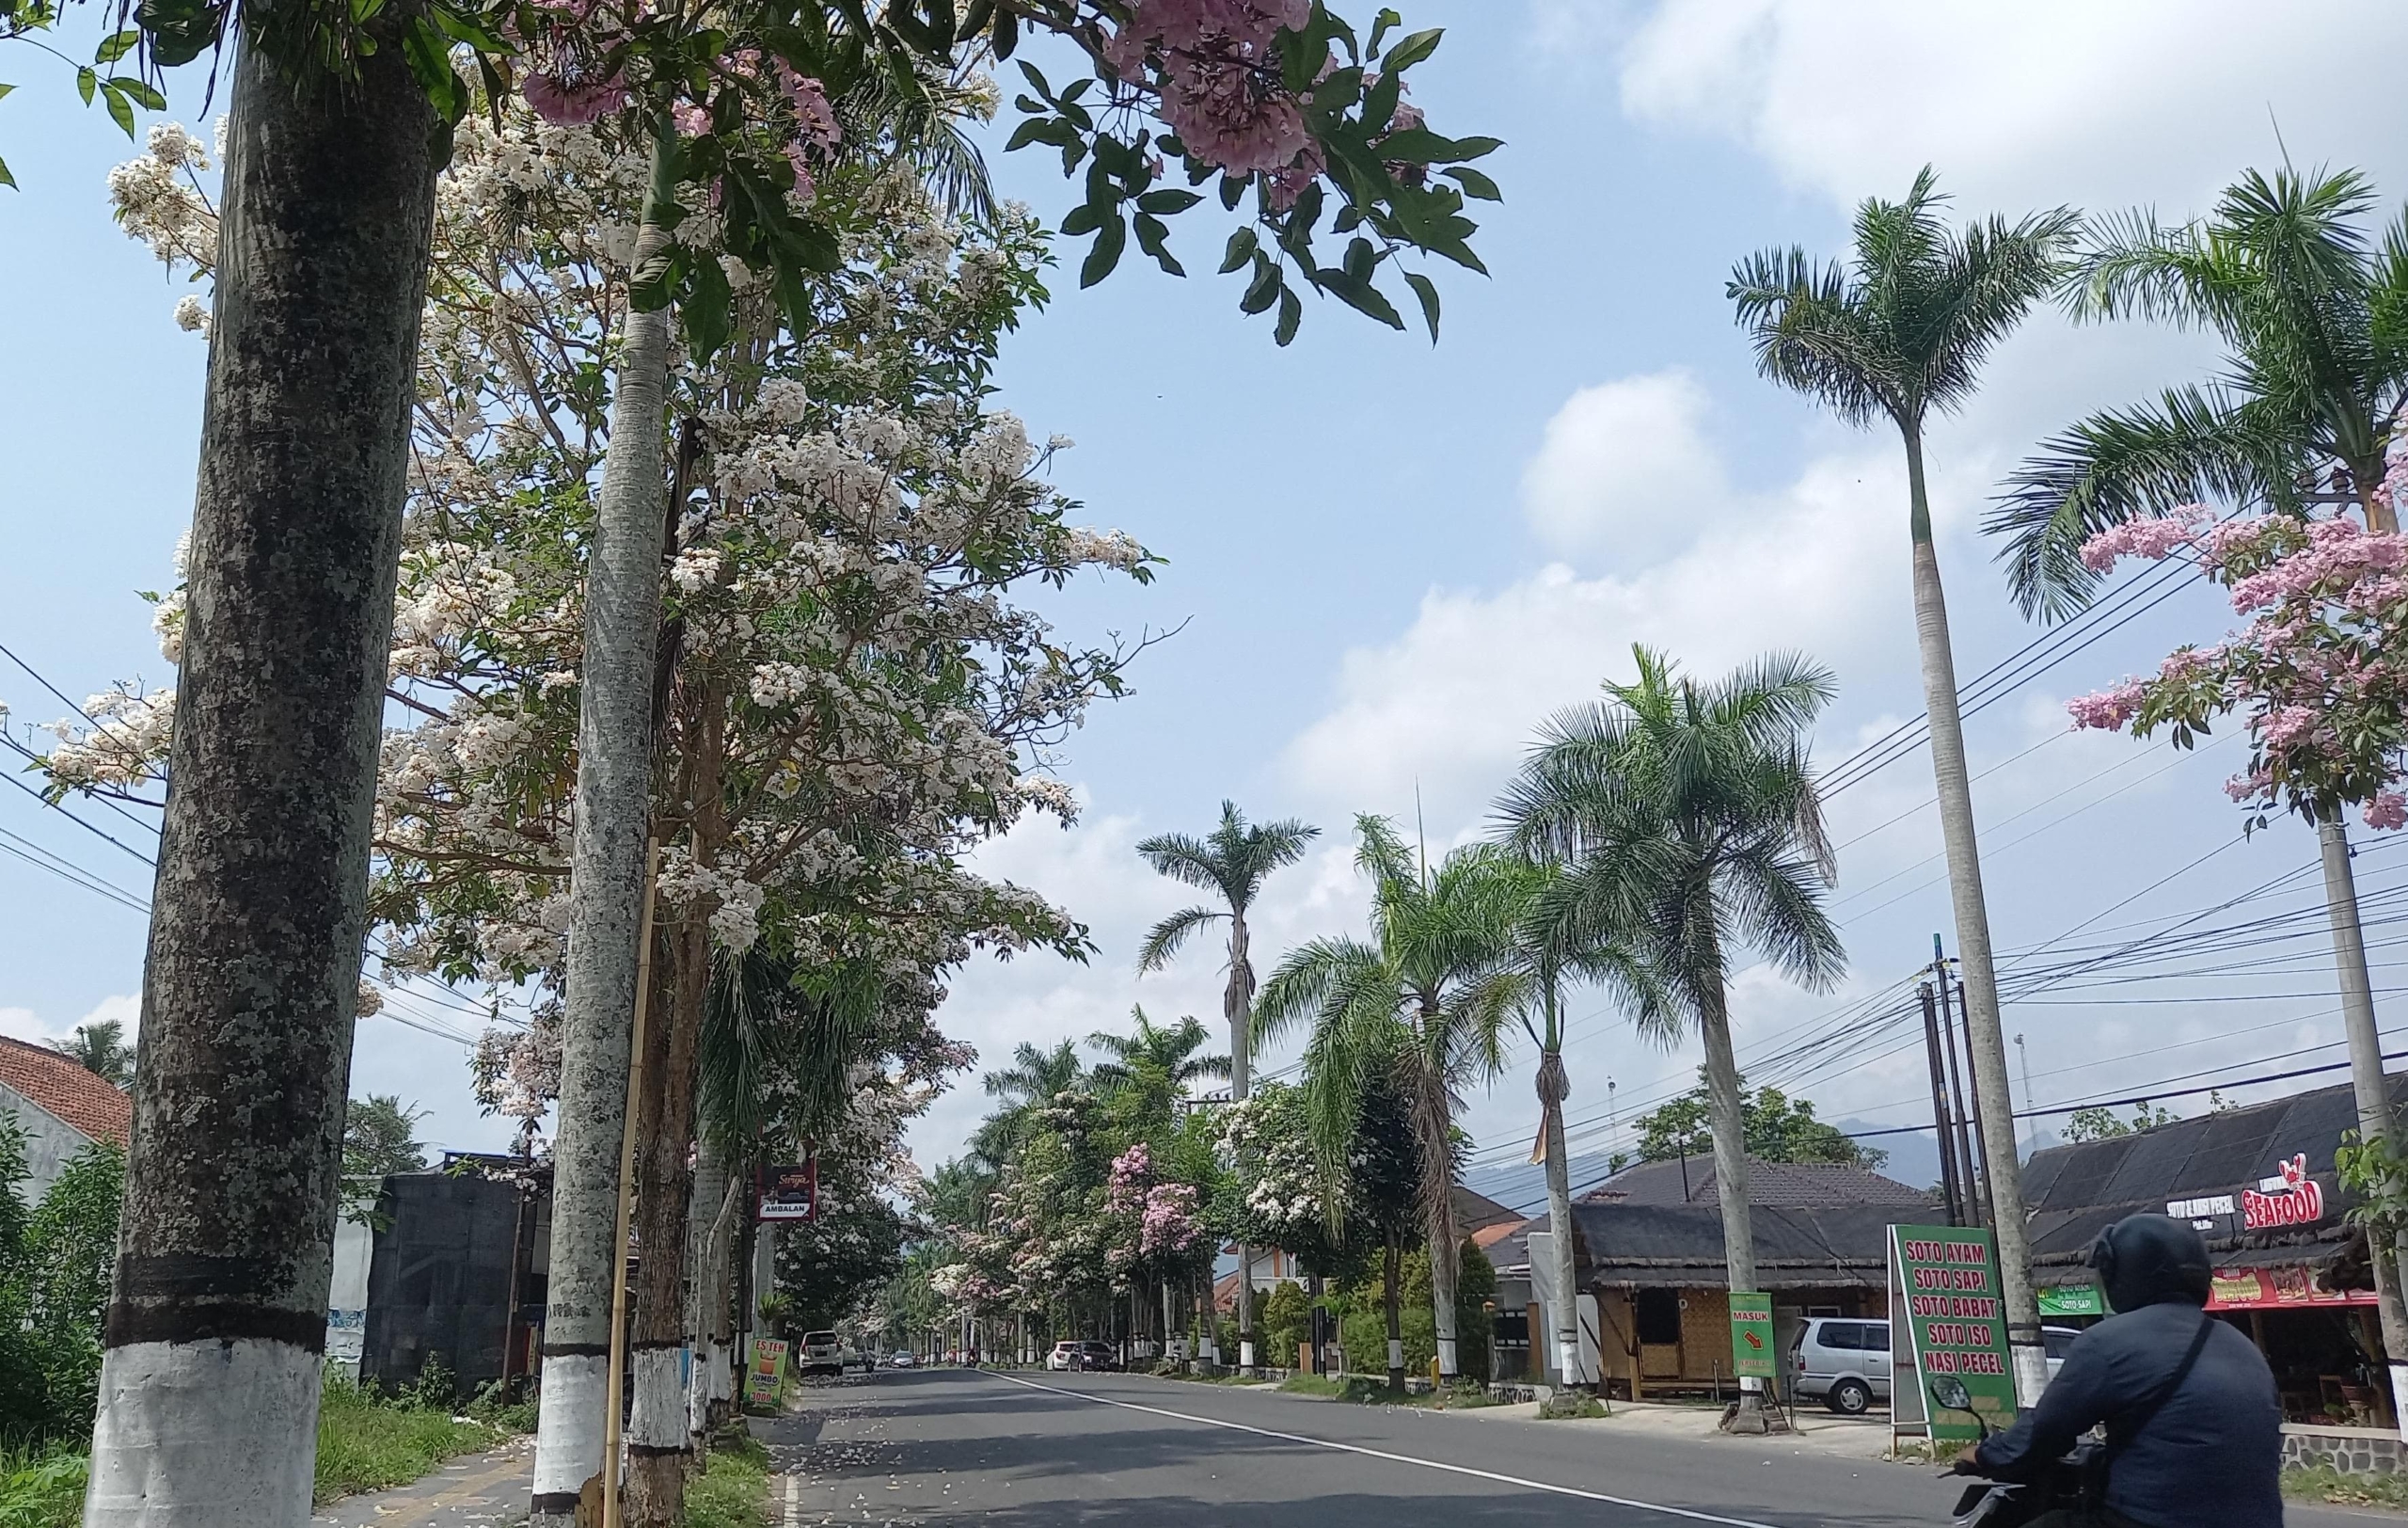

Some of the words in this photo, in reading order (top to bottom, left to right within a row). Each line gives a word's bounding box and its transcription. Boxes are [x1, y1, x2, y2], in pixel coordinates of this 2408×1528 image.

[2242, 1181, 2319, 1229] SEAFOOD
[1905, 1240, 1943, 1263] SOTO
[1945, 1242, 1987, 1265] AYAM
[1913, 1267, 1952, 1290] SOTO
[1953, 1269, 1988, 1292] SAPI
[1912, 1296, 1950, 1317] SOTO
[1951, 1297, 1997, 1319] BABAT
[2061, 1300, 2076, 1309] SOTO
[2077, 1299, 2091, 1309] SAPI
[1733, 1312, 1768, 1322] MASUK
[755, 1340, 767, 1351] ES
[768, 1342, 784, 1353] TEH
[1927, 1324, 1965, 1345] SOTO
[1968, 1325, 1992, 1347] ISO
[1924, 1351, 1958, 1373] NASI
[1960, 1352, 2005, 1375] PECEL
[750, 1374, 780, 1384] JUMBO
